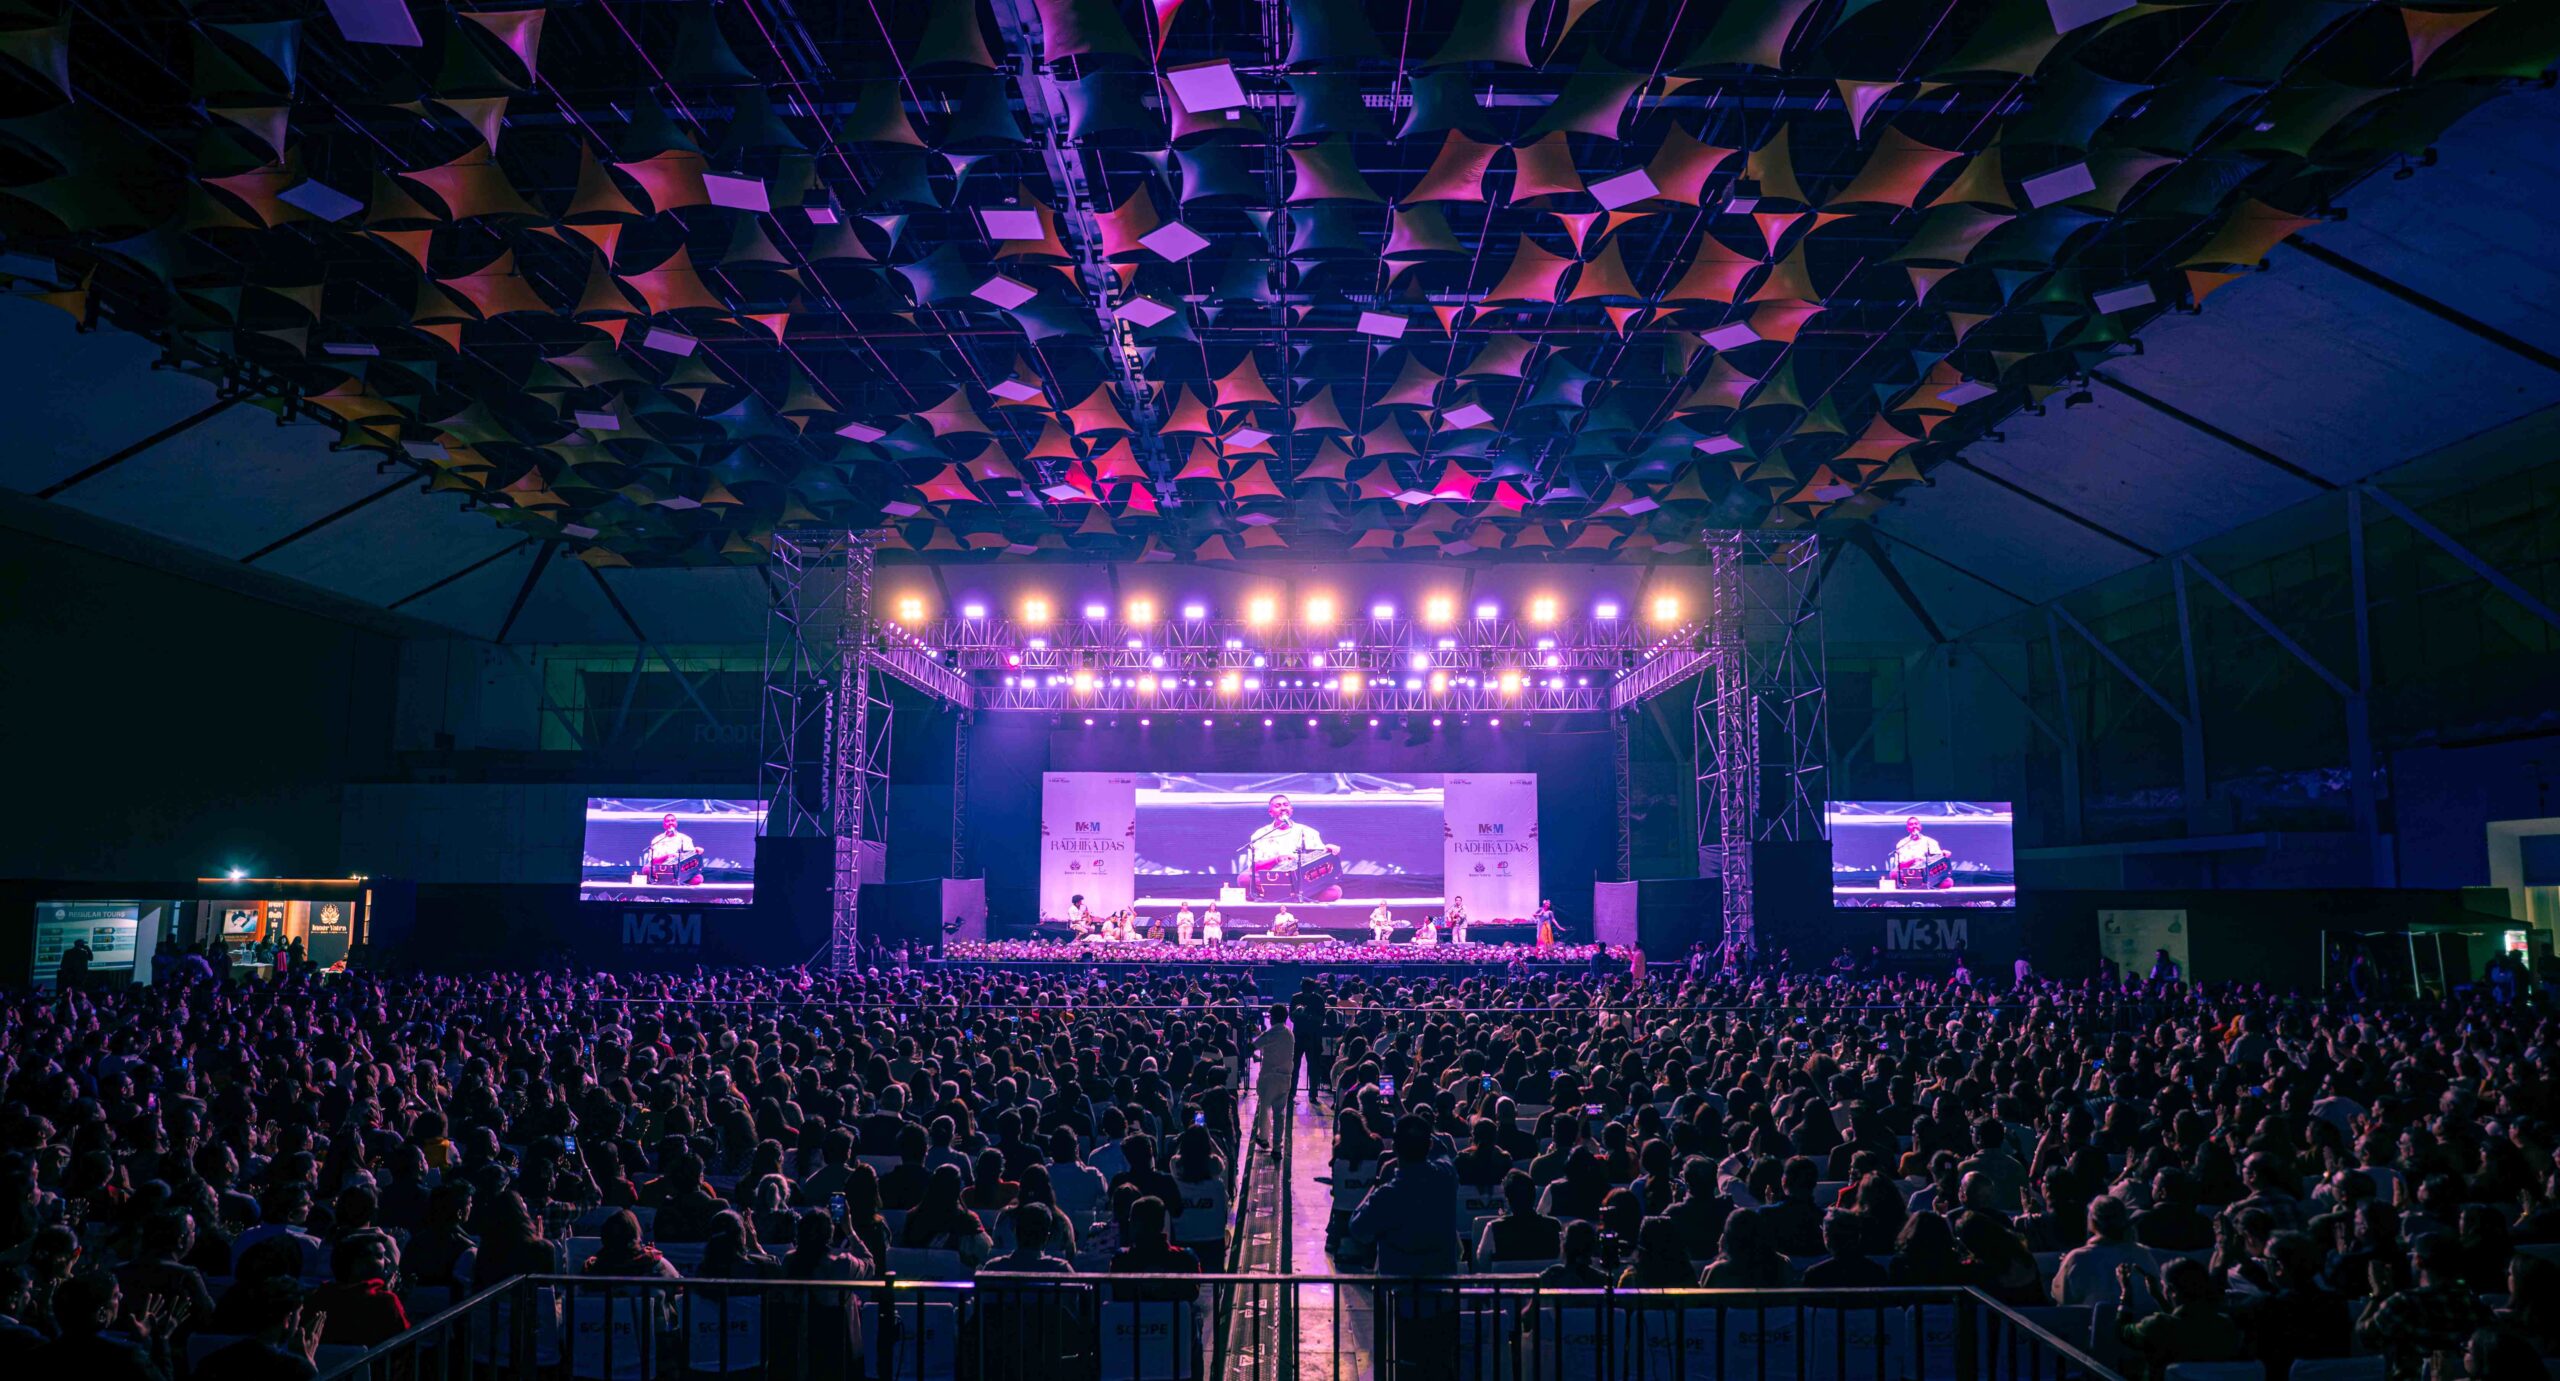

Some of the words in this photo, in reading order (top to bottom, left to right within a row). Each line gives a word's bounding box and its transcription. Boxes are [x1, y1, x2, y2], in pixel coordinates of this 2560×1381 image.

[694, 723, 747, 743] FOOD
[1051, 840, 1098, 851] RADHIKA
[1101, 841, 1125, 851] DAS
[1454, 842, 1502, 853] RADHIKA
[1505, 842, 1529, 853] DAS
[623, 912, 702, 945] M3M
[1886, 918, 1968, 951] M3M
[580, 1321, 631, 1335] SCPE
